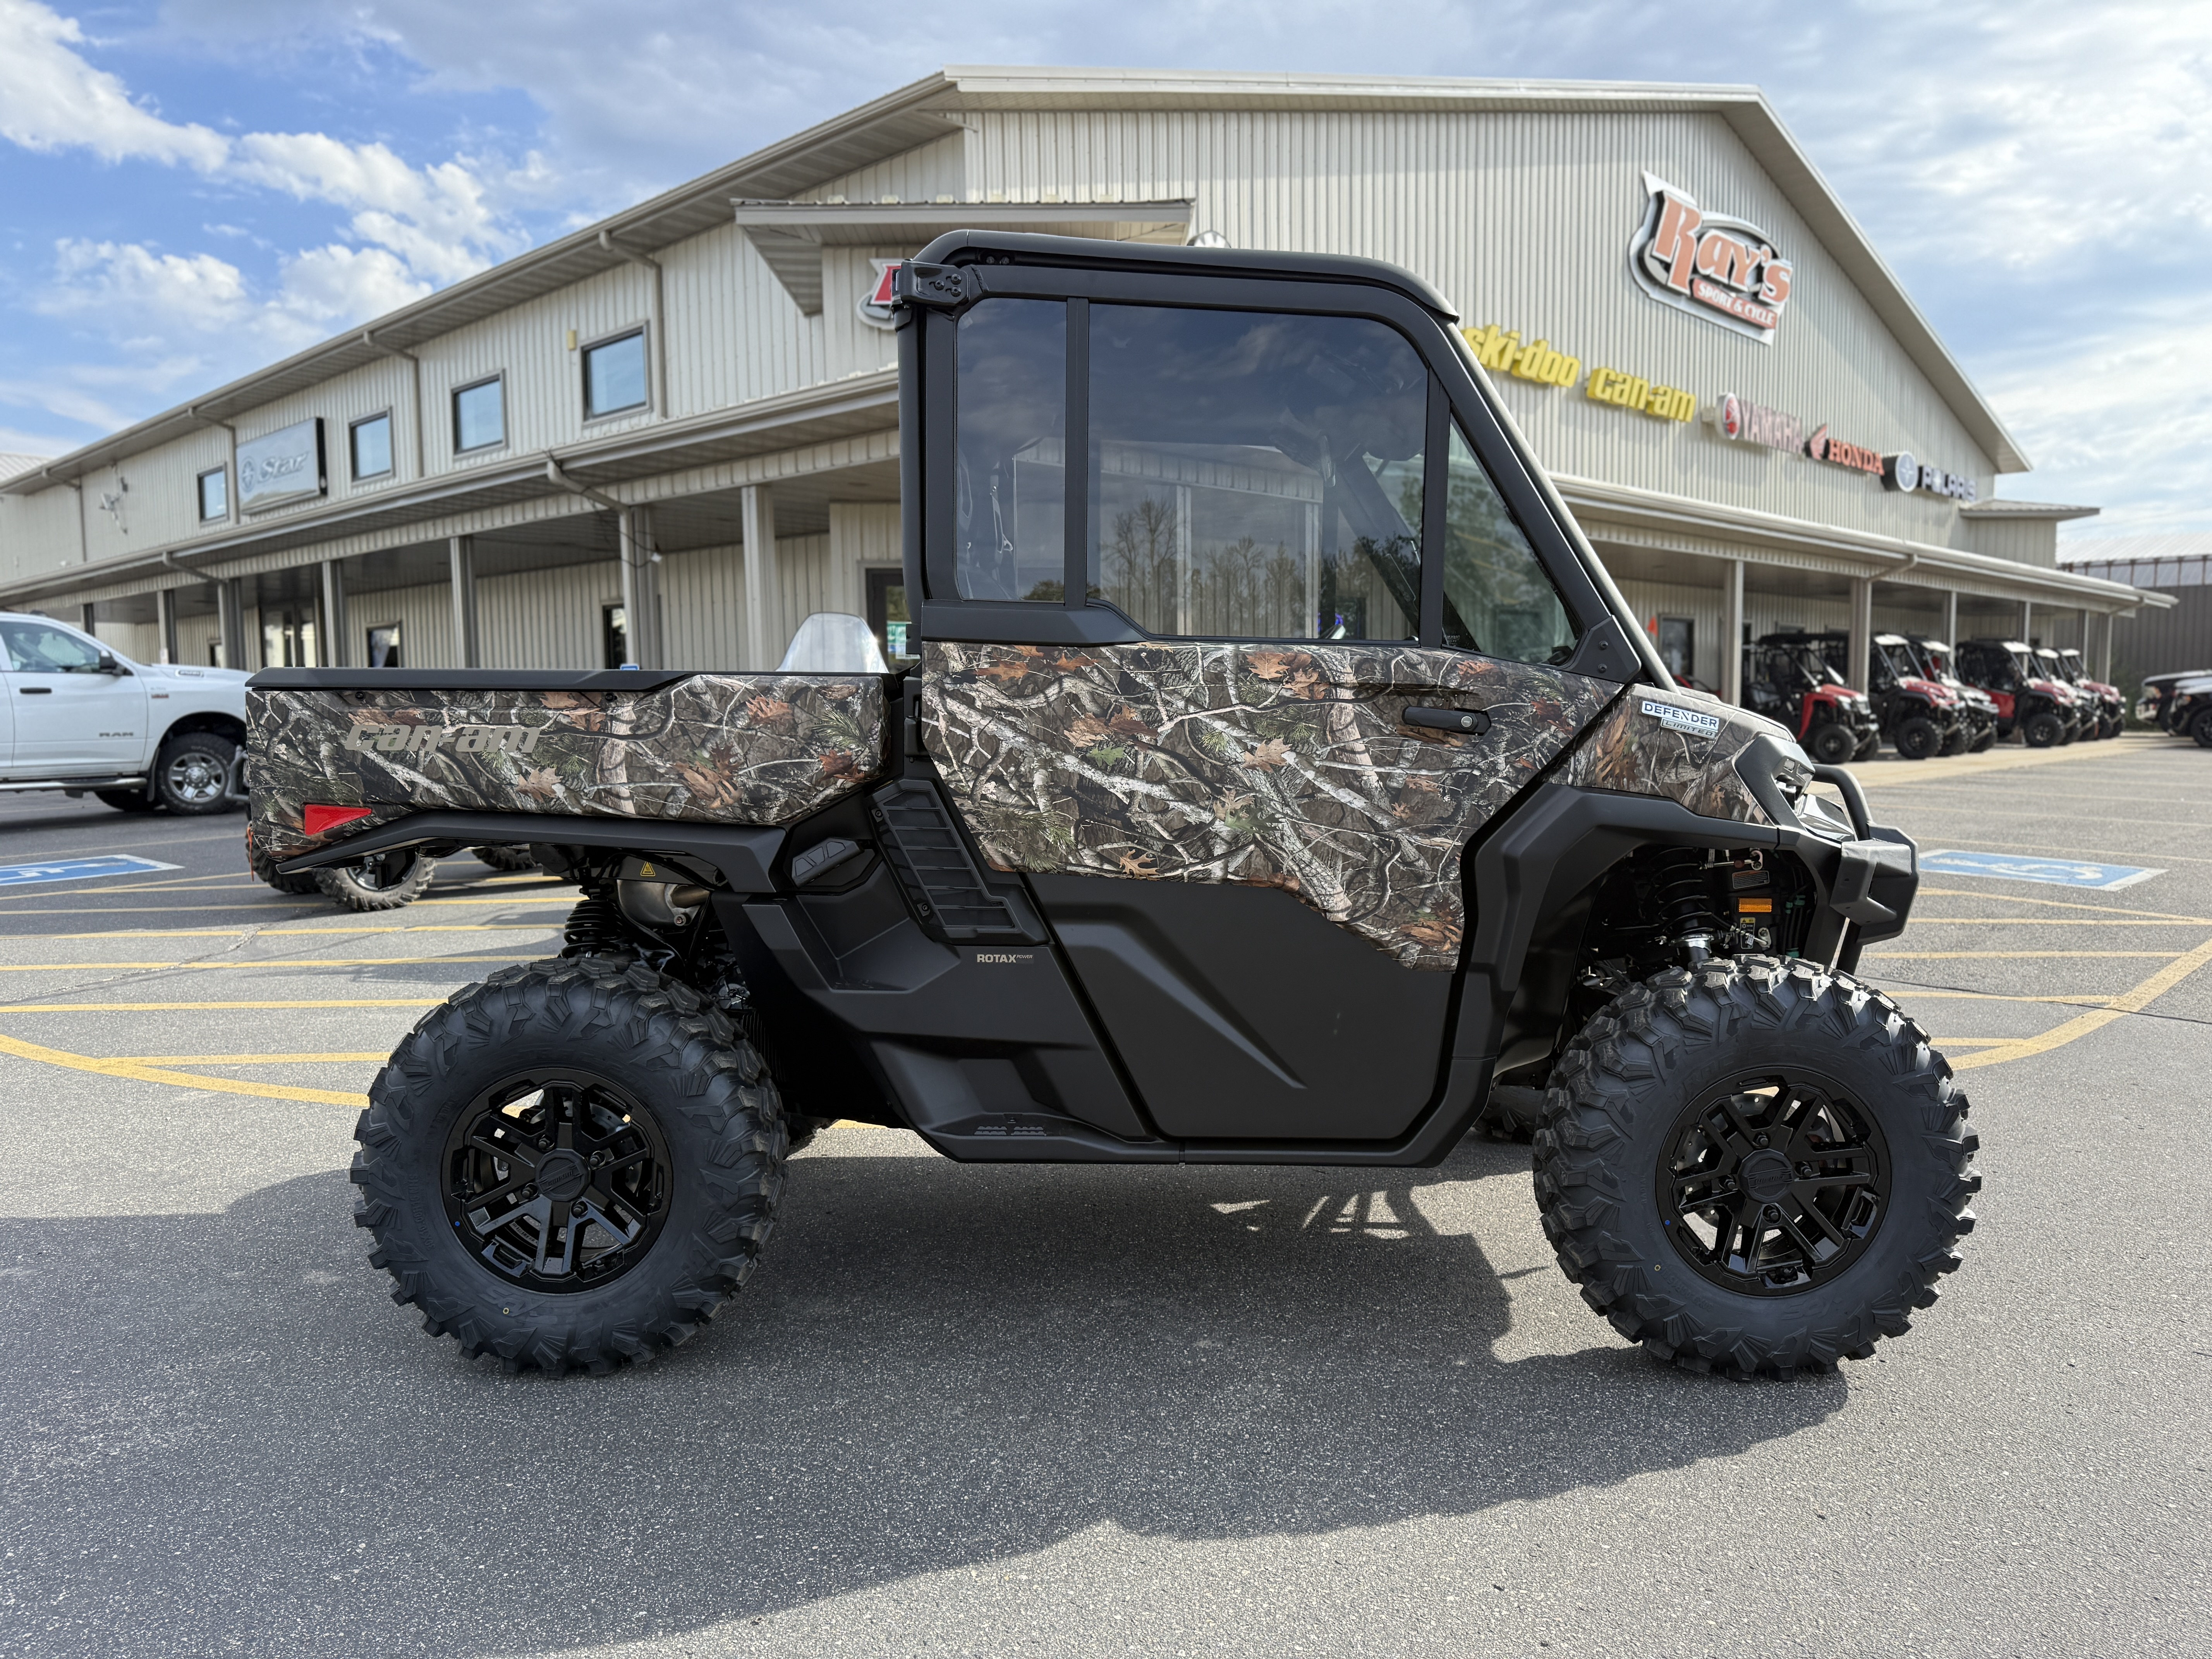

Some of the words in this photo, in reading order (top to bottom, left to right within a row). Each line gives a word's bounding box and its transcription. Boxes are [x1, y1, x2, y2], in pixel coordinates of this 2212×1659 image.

[1652, 192, 1793, 305] Ray's
[1698, 284, 1733, 307] SPORT
[1734, 298, 1743, 313] &
[1744, 304, 1774, 325] CYCLE
[1463, 325, 1580, 388] ski-doo
[1588, 367, 1696, 422] can-am
[1741, 400, 1803, 454] YAMAHA
[258, 451, 309, 484] Star
[1829, 439, 1884, 476] HONDA
[1644, 703, 1717, 728] DEFENDER
[1665, 721, 1714, 736] LIMITED
[345, 725, 541, 753] can-am
[977, 954, 1016, 963] ROTAX
